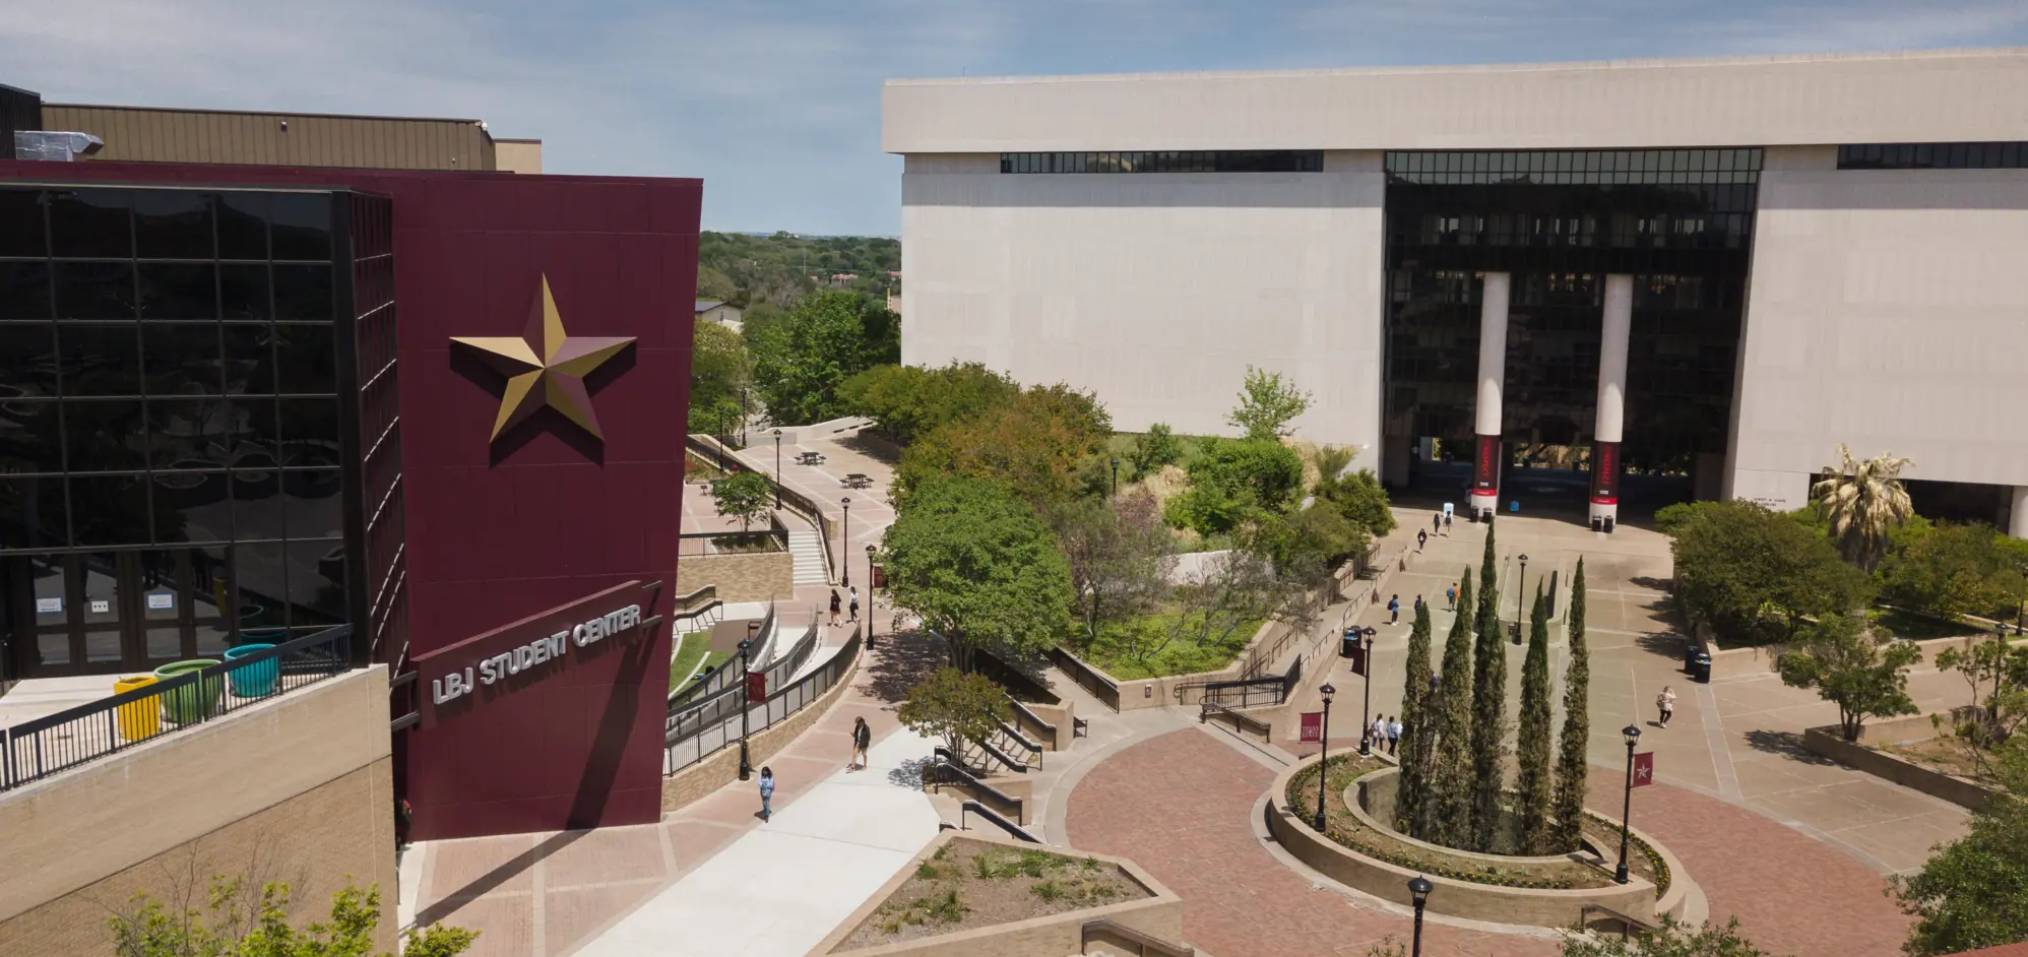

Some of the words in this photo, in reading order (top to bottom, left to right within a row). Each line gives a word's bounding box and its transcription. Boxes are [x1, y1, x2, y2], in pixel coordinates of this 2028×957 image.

[432, 667, 474, 705] LBJ
[479, 630, 569, 685] STUDENT
[573, 604, 641, 647] CENTER
